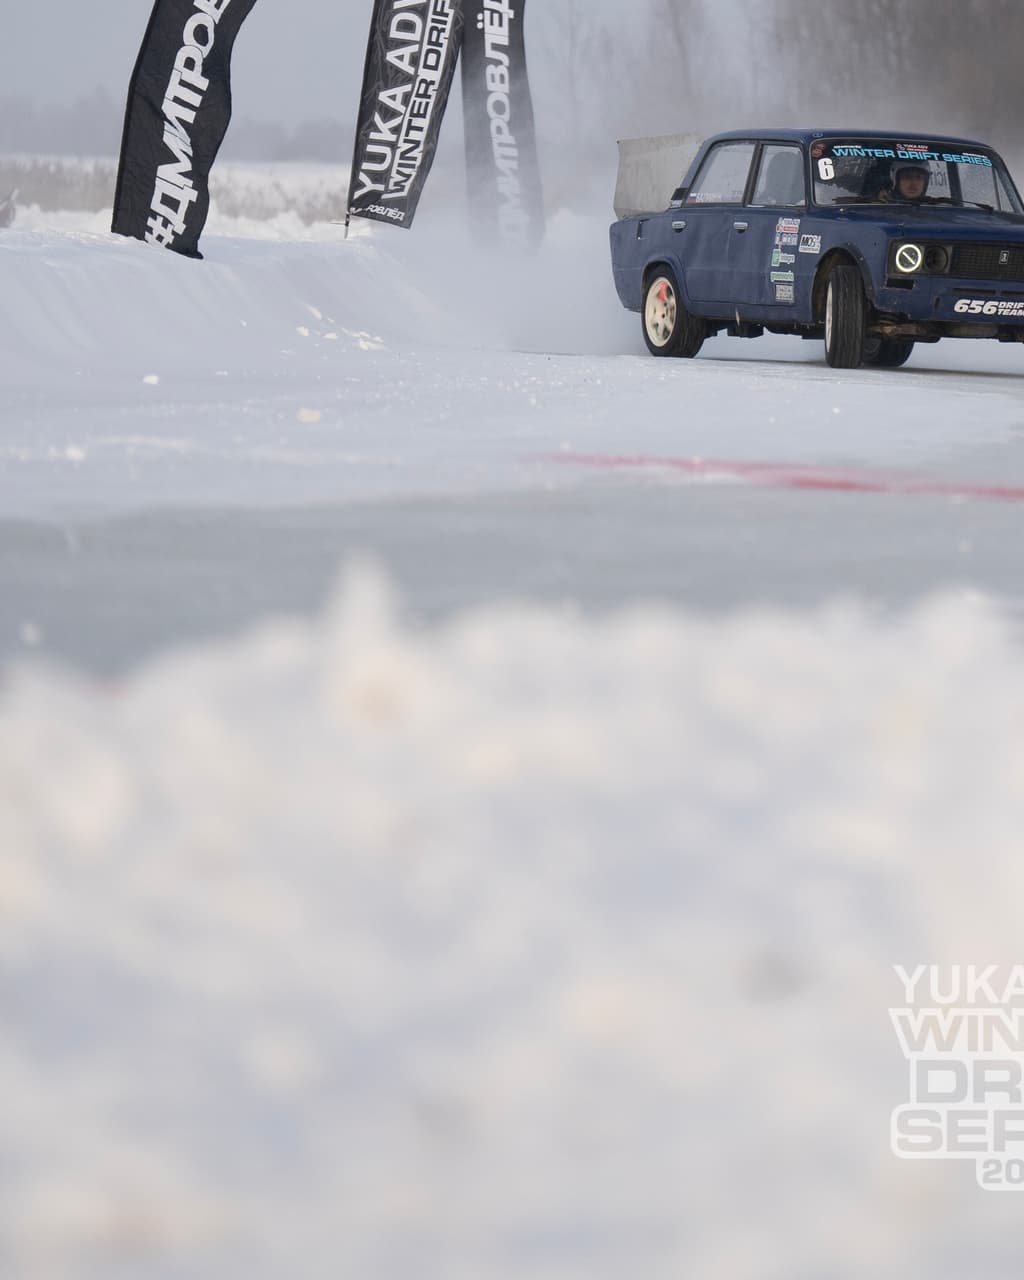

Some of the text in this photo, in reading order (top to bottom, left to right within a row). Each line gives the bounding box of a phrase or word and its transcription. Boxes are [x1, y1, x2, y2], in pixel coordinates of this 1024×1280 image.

[353, 84, 413, 199] YUKA
[391, 78, 436, 196] WINTER
[817, 157, 835, 181] 6
[832, 148, 895, 157] WINTER
[897, 149, 940, 161] DRIFT
[943, 153, 993, 167] SERIES
[953, 299, 999, 315] 656
